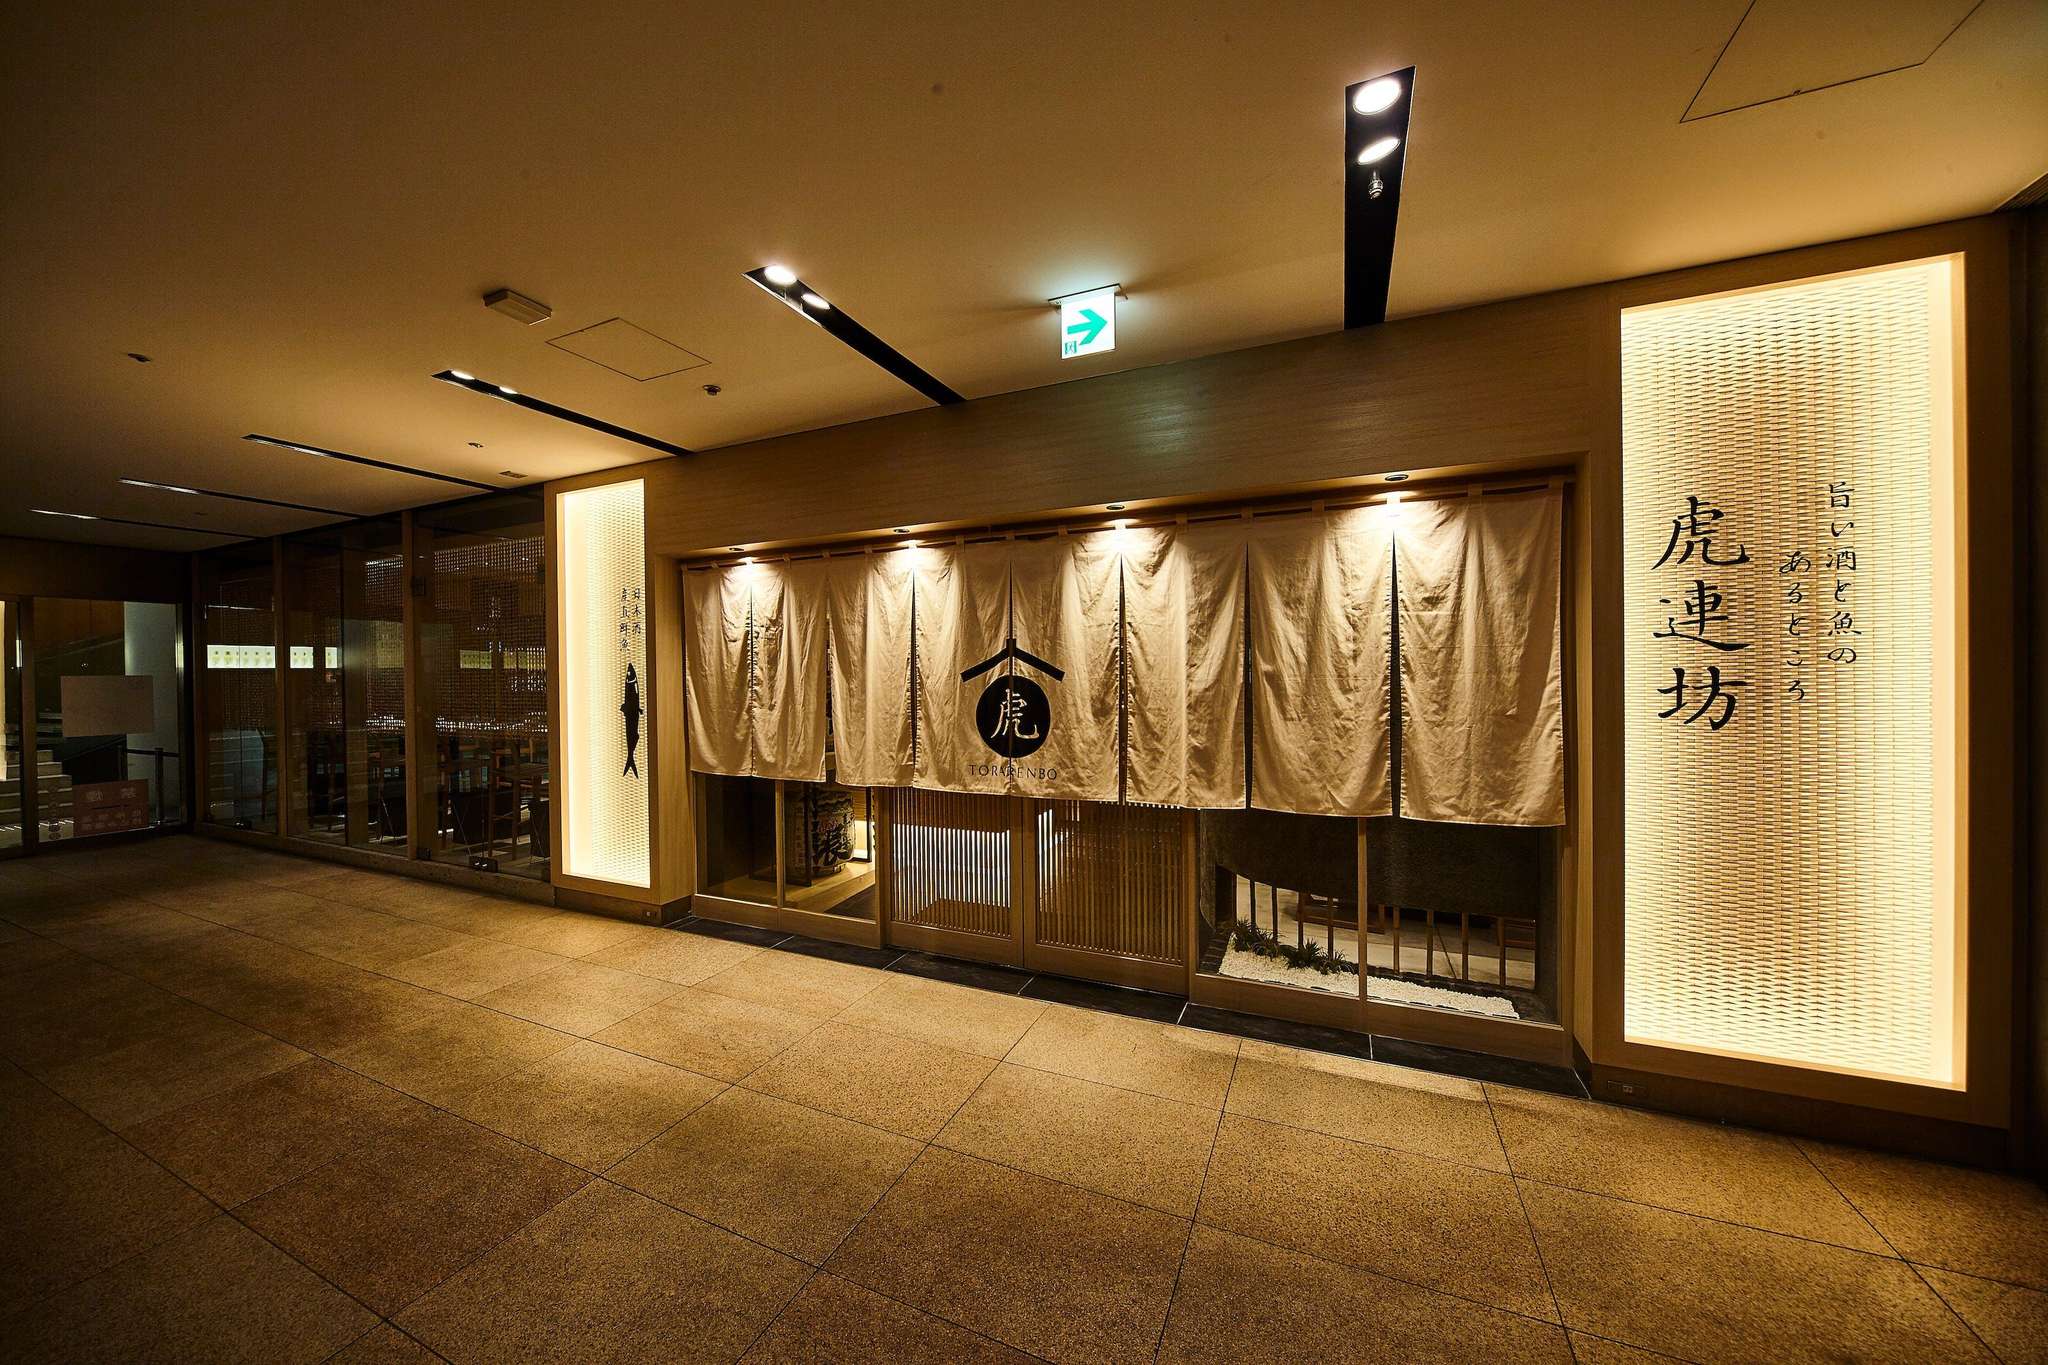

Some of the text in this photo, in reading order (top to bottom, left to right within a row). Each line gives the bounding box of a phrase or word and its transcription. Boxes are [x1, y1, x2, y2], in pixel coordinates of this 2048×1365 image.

[1651, 496, 1750, 731] 虎連坊
[1779, 551, 1811, 701] あるところ
[1826, 481, 1861, 664] 旨い酒と魚の
[969, 765, 1057, 780] TORARENBO
[990, 688, 1040, 739] 虎
